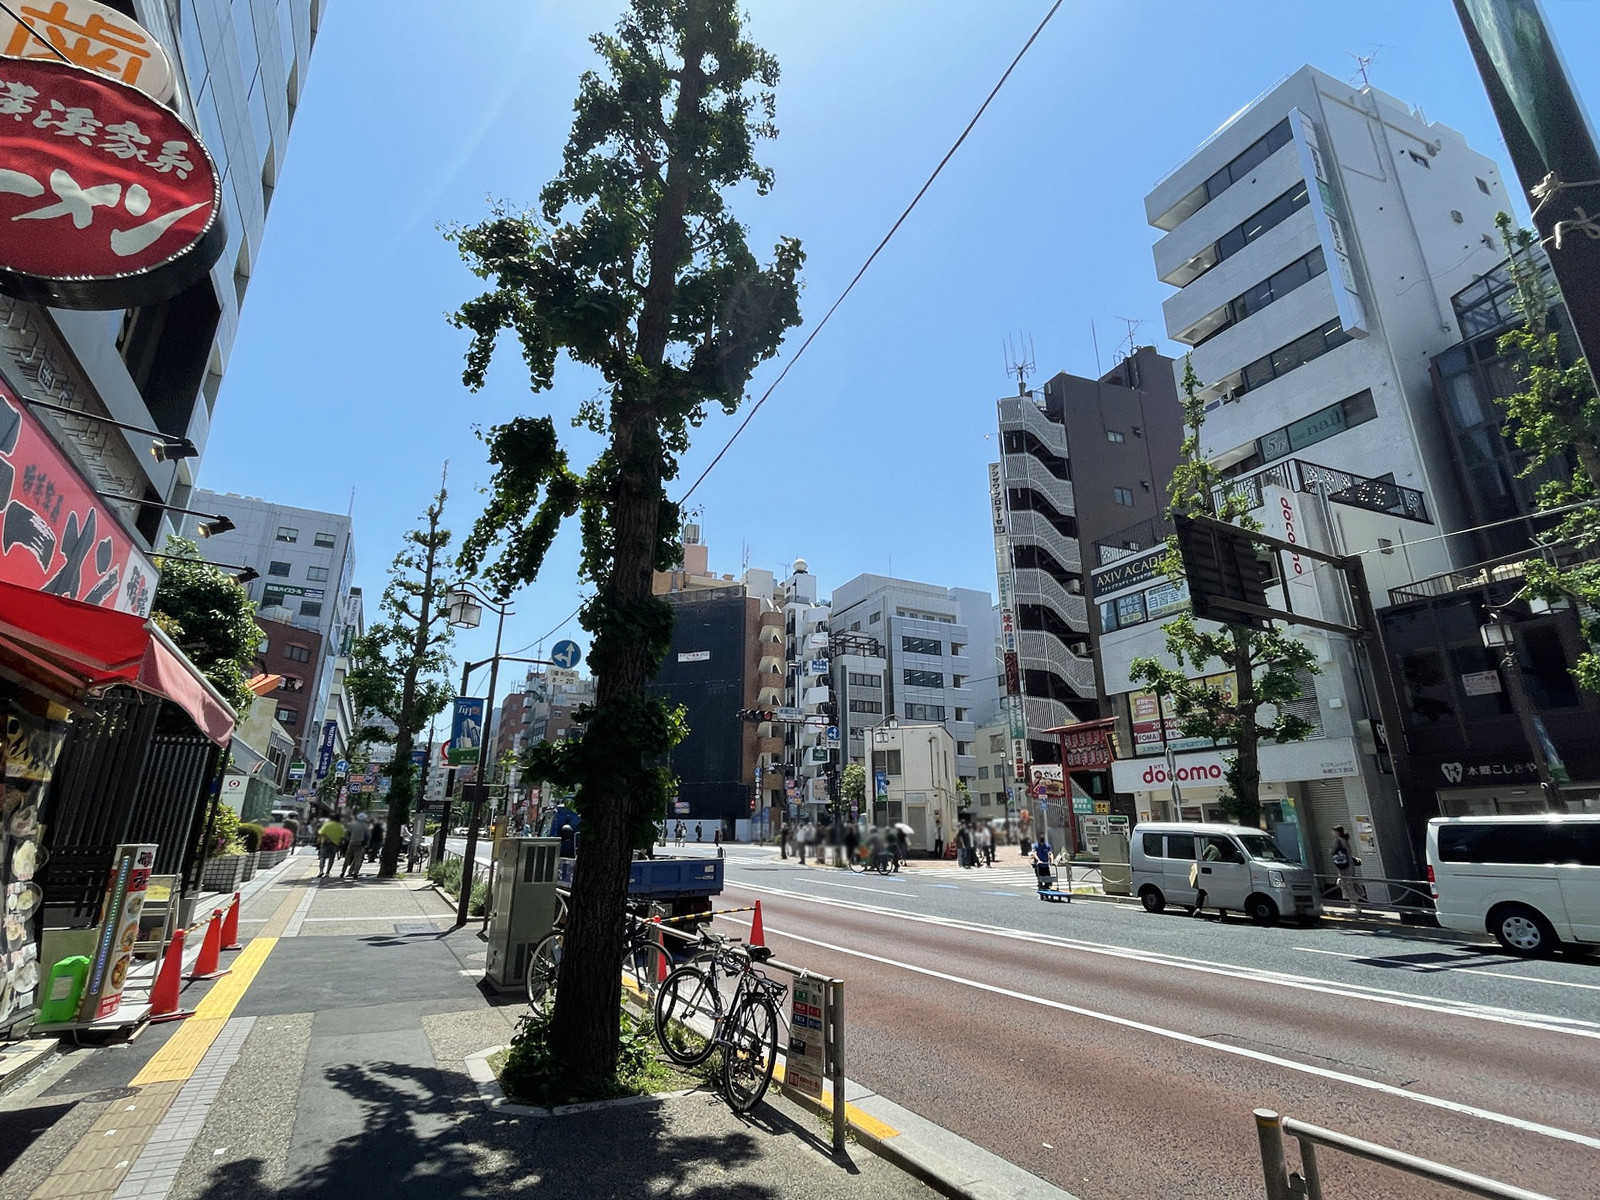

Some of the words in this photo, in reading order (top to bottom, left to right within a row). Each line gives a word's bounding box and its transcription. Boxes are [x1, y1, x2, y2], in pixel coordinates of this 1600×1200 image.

[1306, 410, 1342, 436] nail
[1096, 569, 1122, 588] AXIV
[1119, 594, 1141, 607] 高校生
[1149, 590, 1180, 609] 自習室
